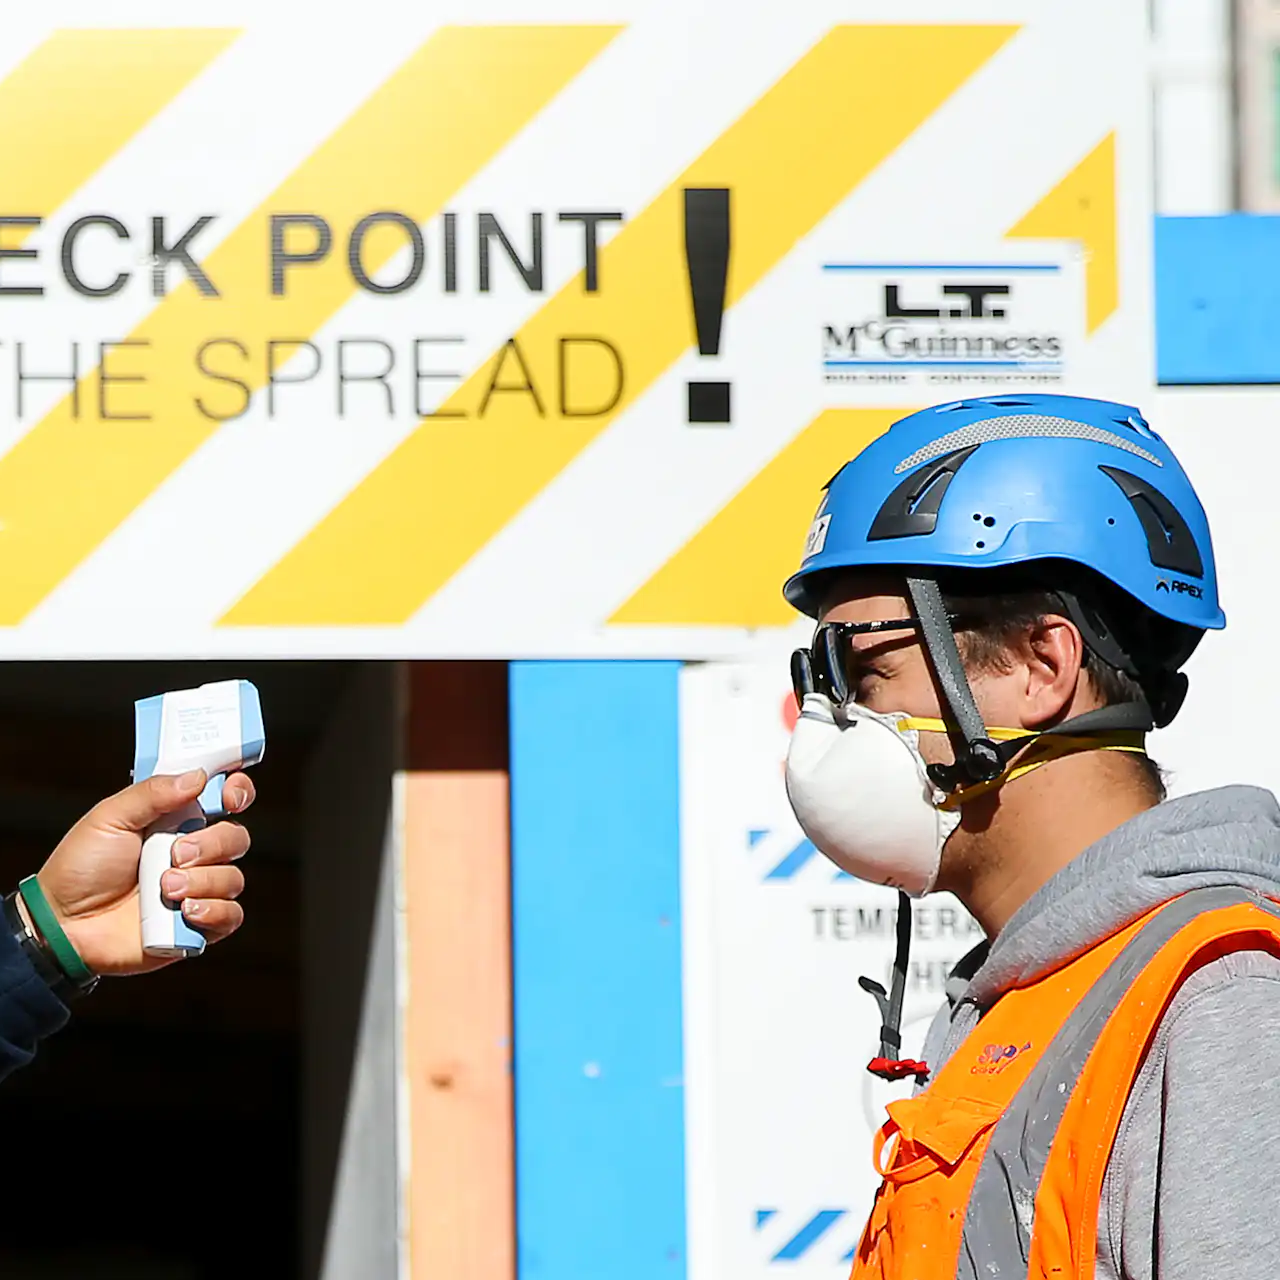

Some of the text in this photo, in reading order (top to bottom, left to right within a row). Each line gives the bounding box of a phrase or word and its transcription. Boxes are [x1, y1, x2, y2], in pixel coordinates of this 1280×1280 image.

[269, 211, 624, 296] POINT
[885, 285, 1010, 317] L.T.
[824, 320, 1062, 358] McGuinness
[193, 337, 627, 422] SPREAD
